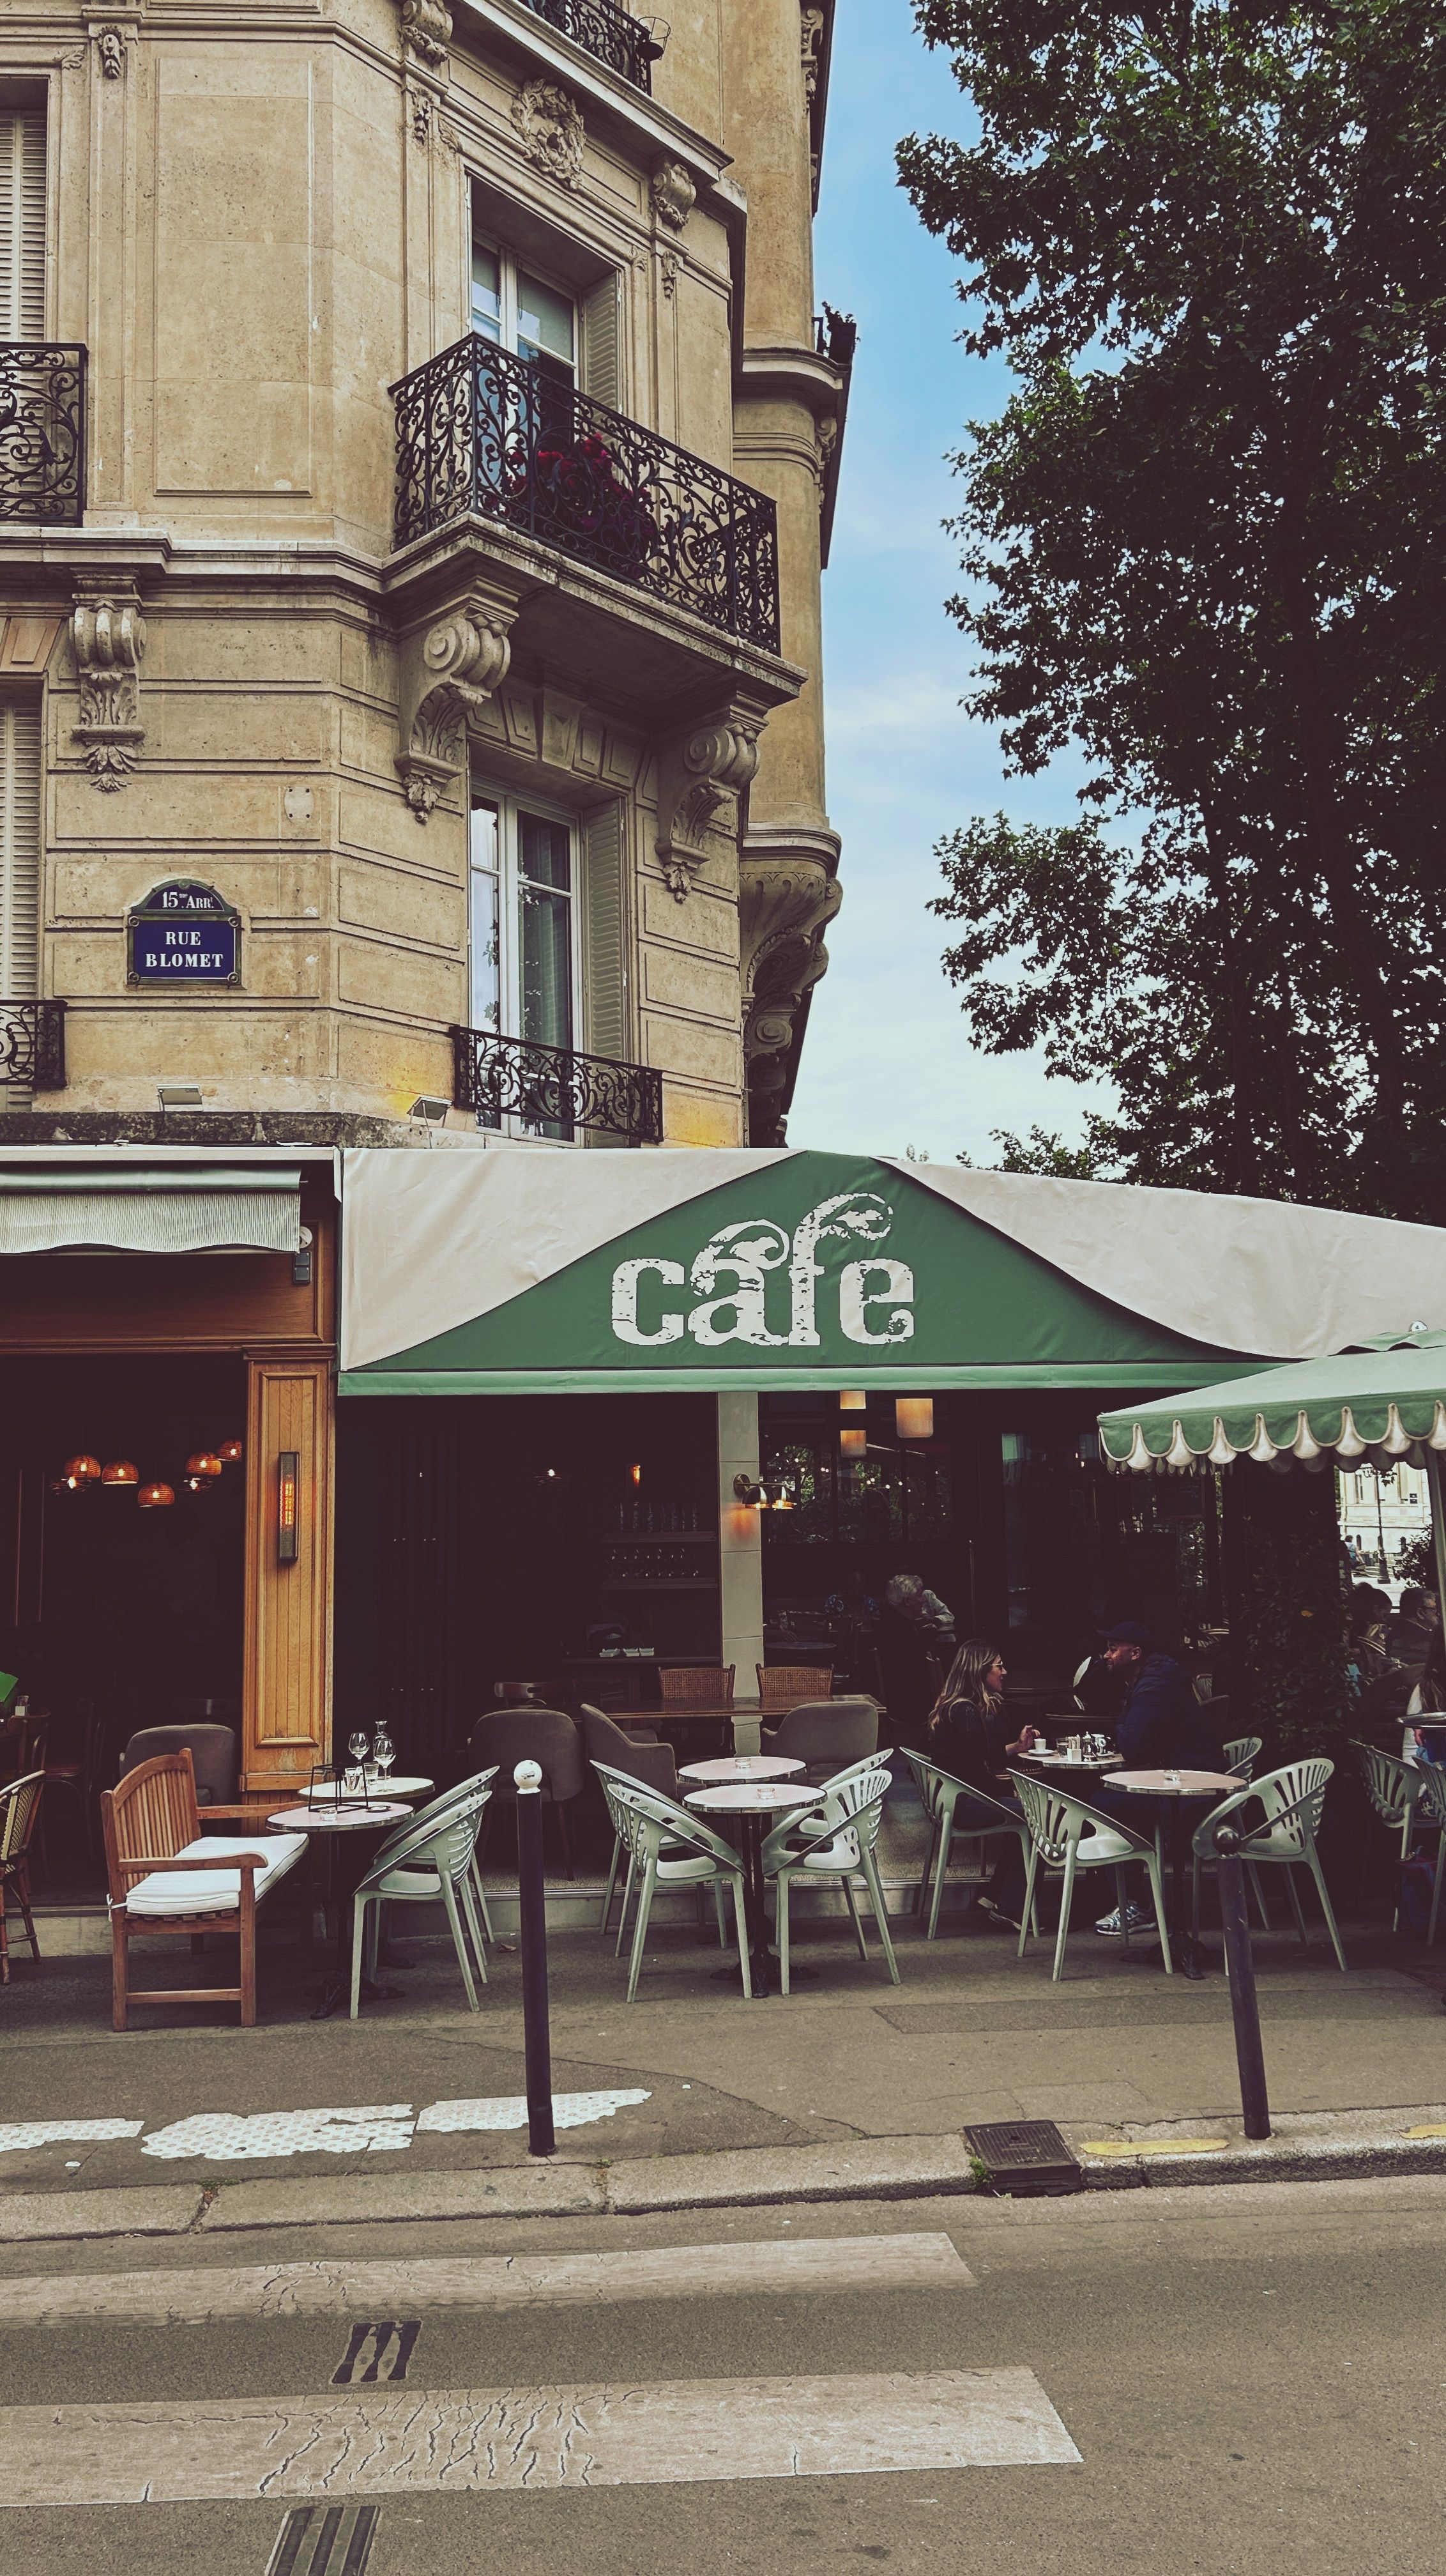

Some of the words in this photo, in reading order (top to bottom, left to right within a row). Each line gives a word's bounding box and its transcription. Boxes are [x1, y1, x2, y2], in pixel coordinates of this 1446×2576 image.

[165, 931, 201, 946] RUE
[146, 953, 224, 967] BLOMET
[611, 1193, 914, 1346] cafe
